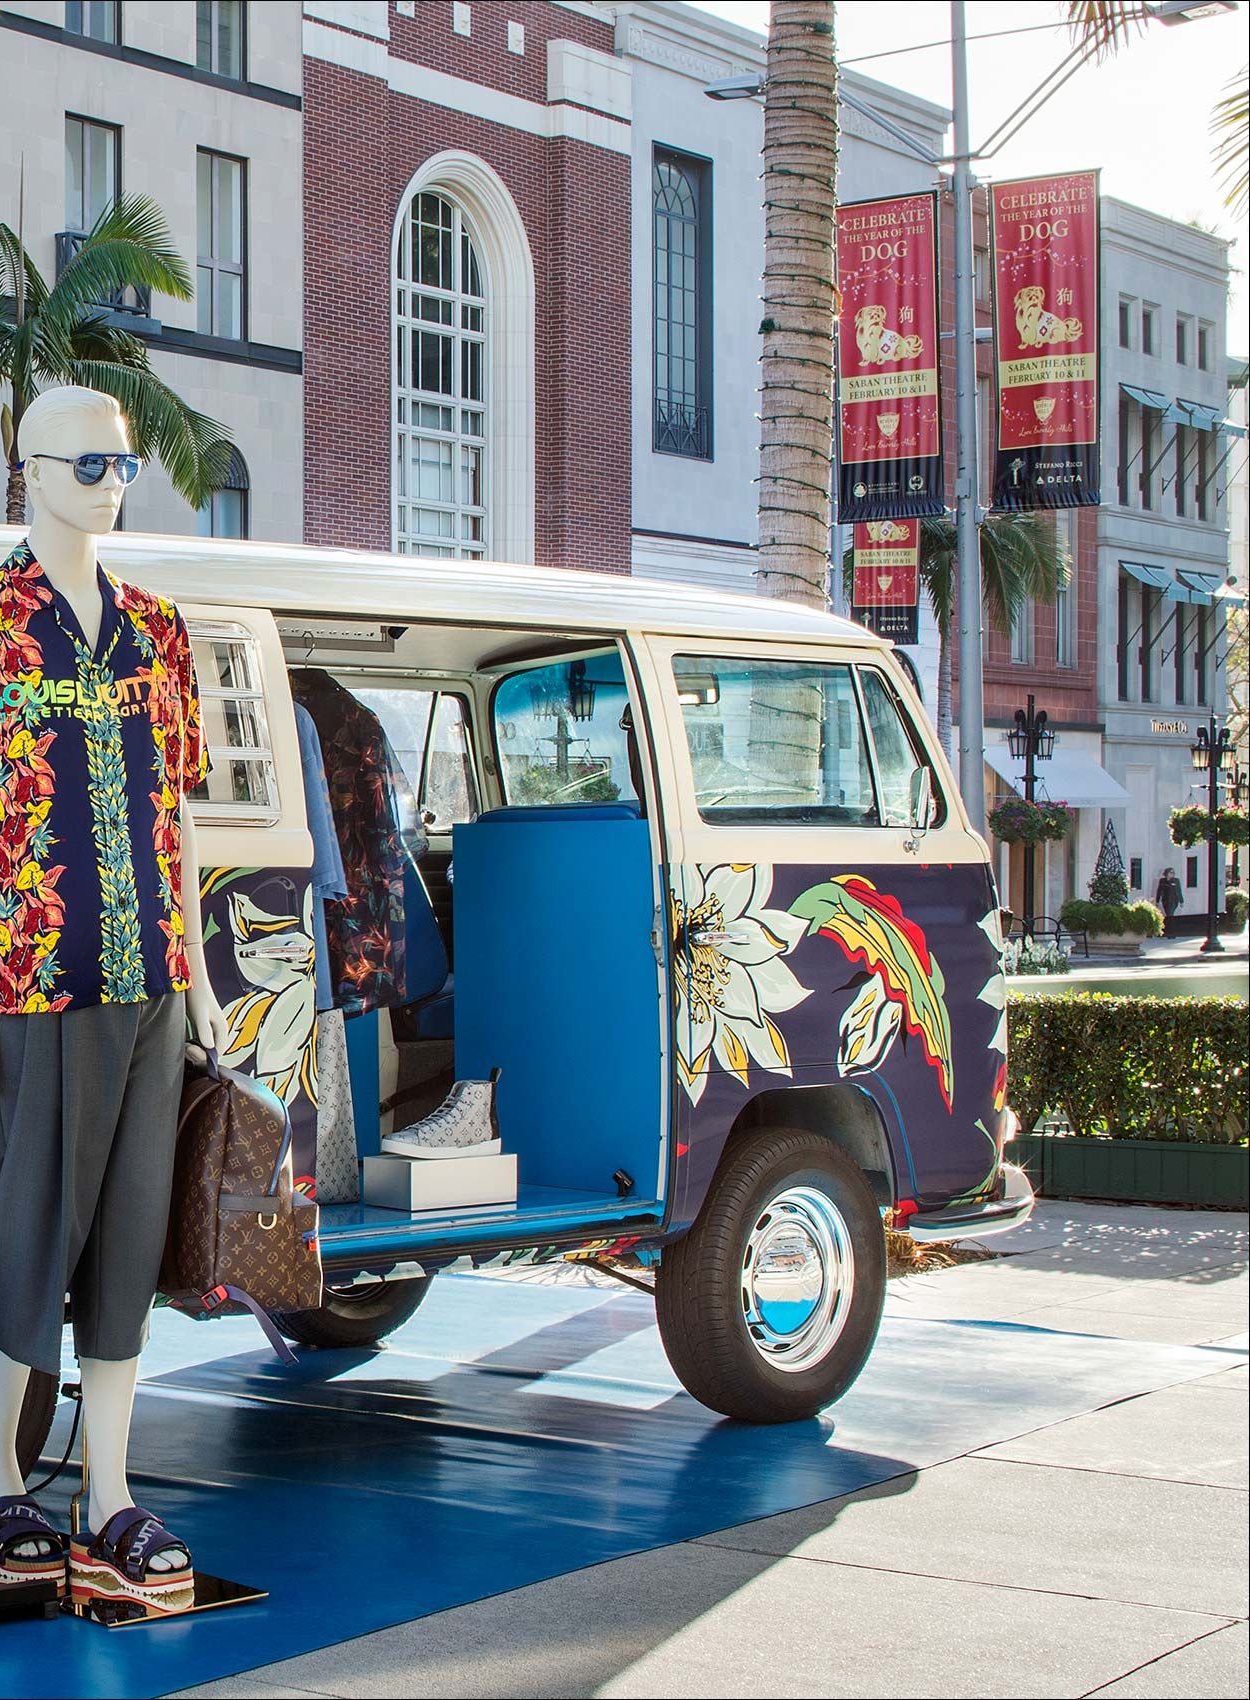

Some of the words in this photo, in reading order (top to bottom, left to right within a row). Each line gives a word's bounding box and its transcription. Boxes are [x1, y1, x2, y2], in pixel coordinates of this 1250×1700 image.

[999, 187, 1088, 210] CELEBRATE
[842, 208, 927, 231] CELEBRATE
[1001, 212, 1021, 222] THE
[1022, 207, 1048, 219] YEAR
[1050, 206, 1064, 216] OF
[1066, 204, 1088, 215] THE
[843, 234, 862, 244] THE
[863, 229, 889, 241] YEAR
[890, 227, 903, 238] OF
[905, 225, 926, 235] THE
[1019, 219, 1069, 242] DOG
[860, 240, 908, 263] DOG
[1056, 287, 1073, 305] 狗
[898, 305, 914, 324] 狗
[1008, 361, 1039, 373] SABAN
[1040, 357, 1087, 369] THEATRE
[849, 378, 881, 390] SABAN
[883, 373, 927, 384] THEATRE
[1008, 372, 1051, 385] FEBRUARY
[1055, 372, 1065, 380] 10
[1076, 370, 1086, 378] 11
[849, 387, 896, 401] FEBRUARY
[898, 386, 908, 395] 10
[909, 385, 917, 394] &
[918, 384, 927, 393] 11
[1047, 475, 1083, 484] DELTA
